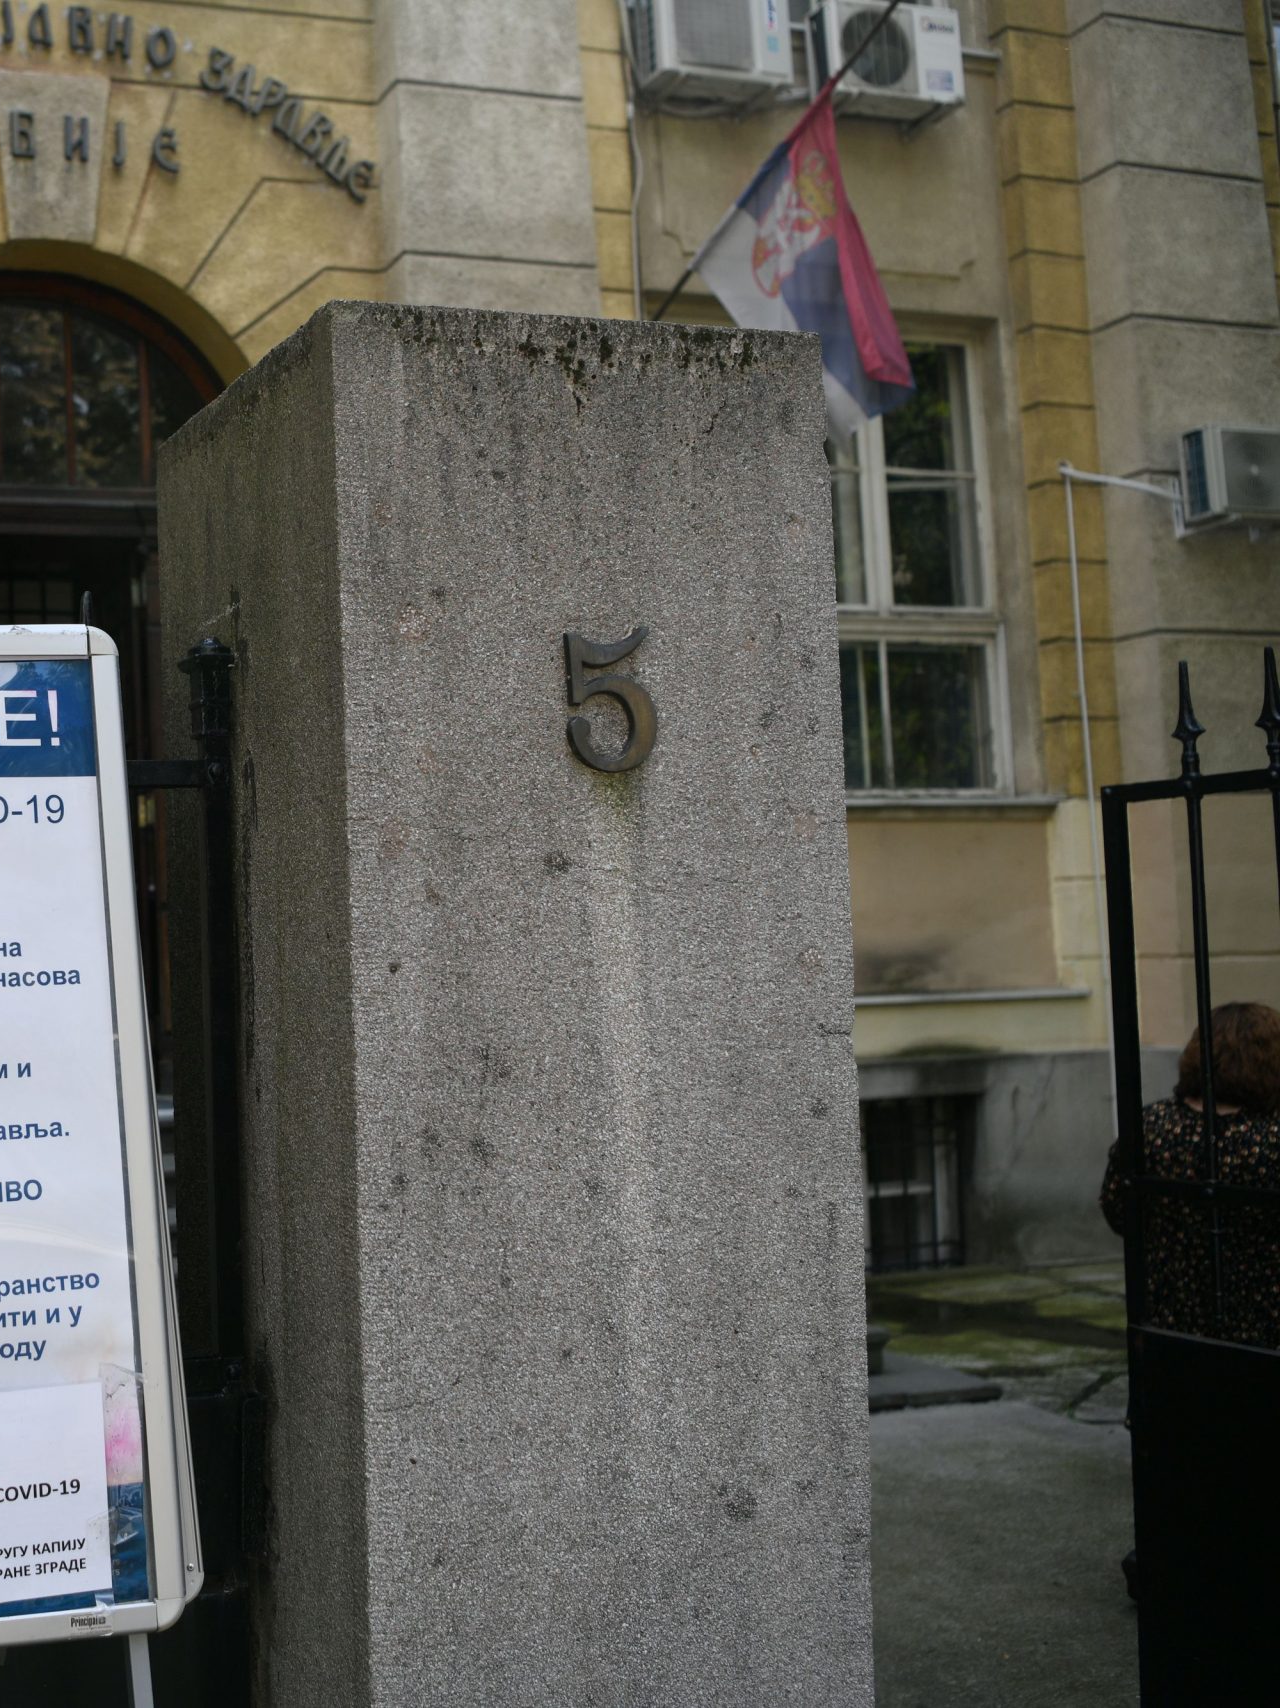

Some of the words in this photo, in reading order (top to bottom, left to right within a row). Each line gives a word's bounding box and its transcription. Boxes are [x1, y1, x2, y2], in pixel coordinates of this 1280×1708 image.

[562, 625, 658, 774] 5
[17, 1061, 32, 1079] и
[45, 1307, 61, 1325] и
[67, 1304, 83, 1328] у
[31, 1537, 86, 1556] КАПИЈУ
[34, 1557, 87, 1576] ЗГРАДЕ
